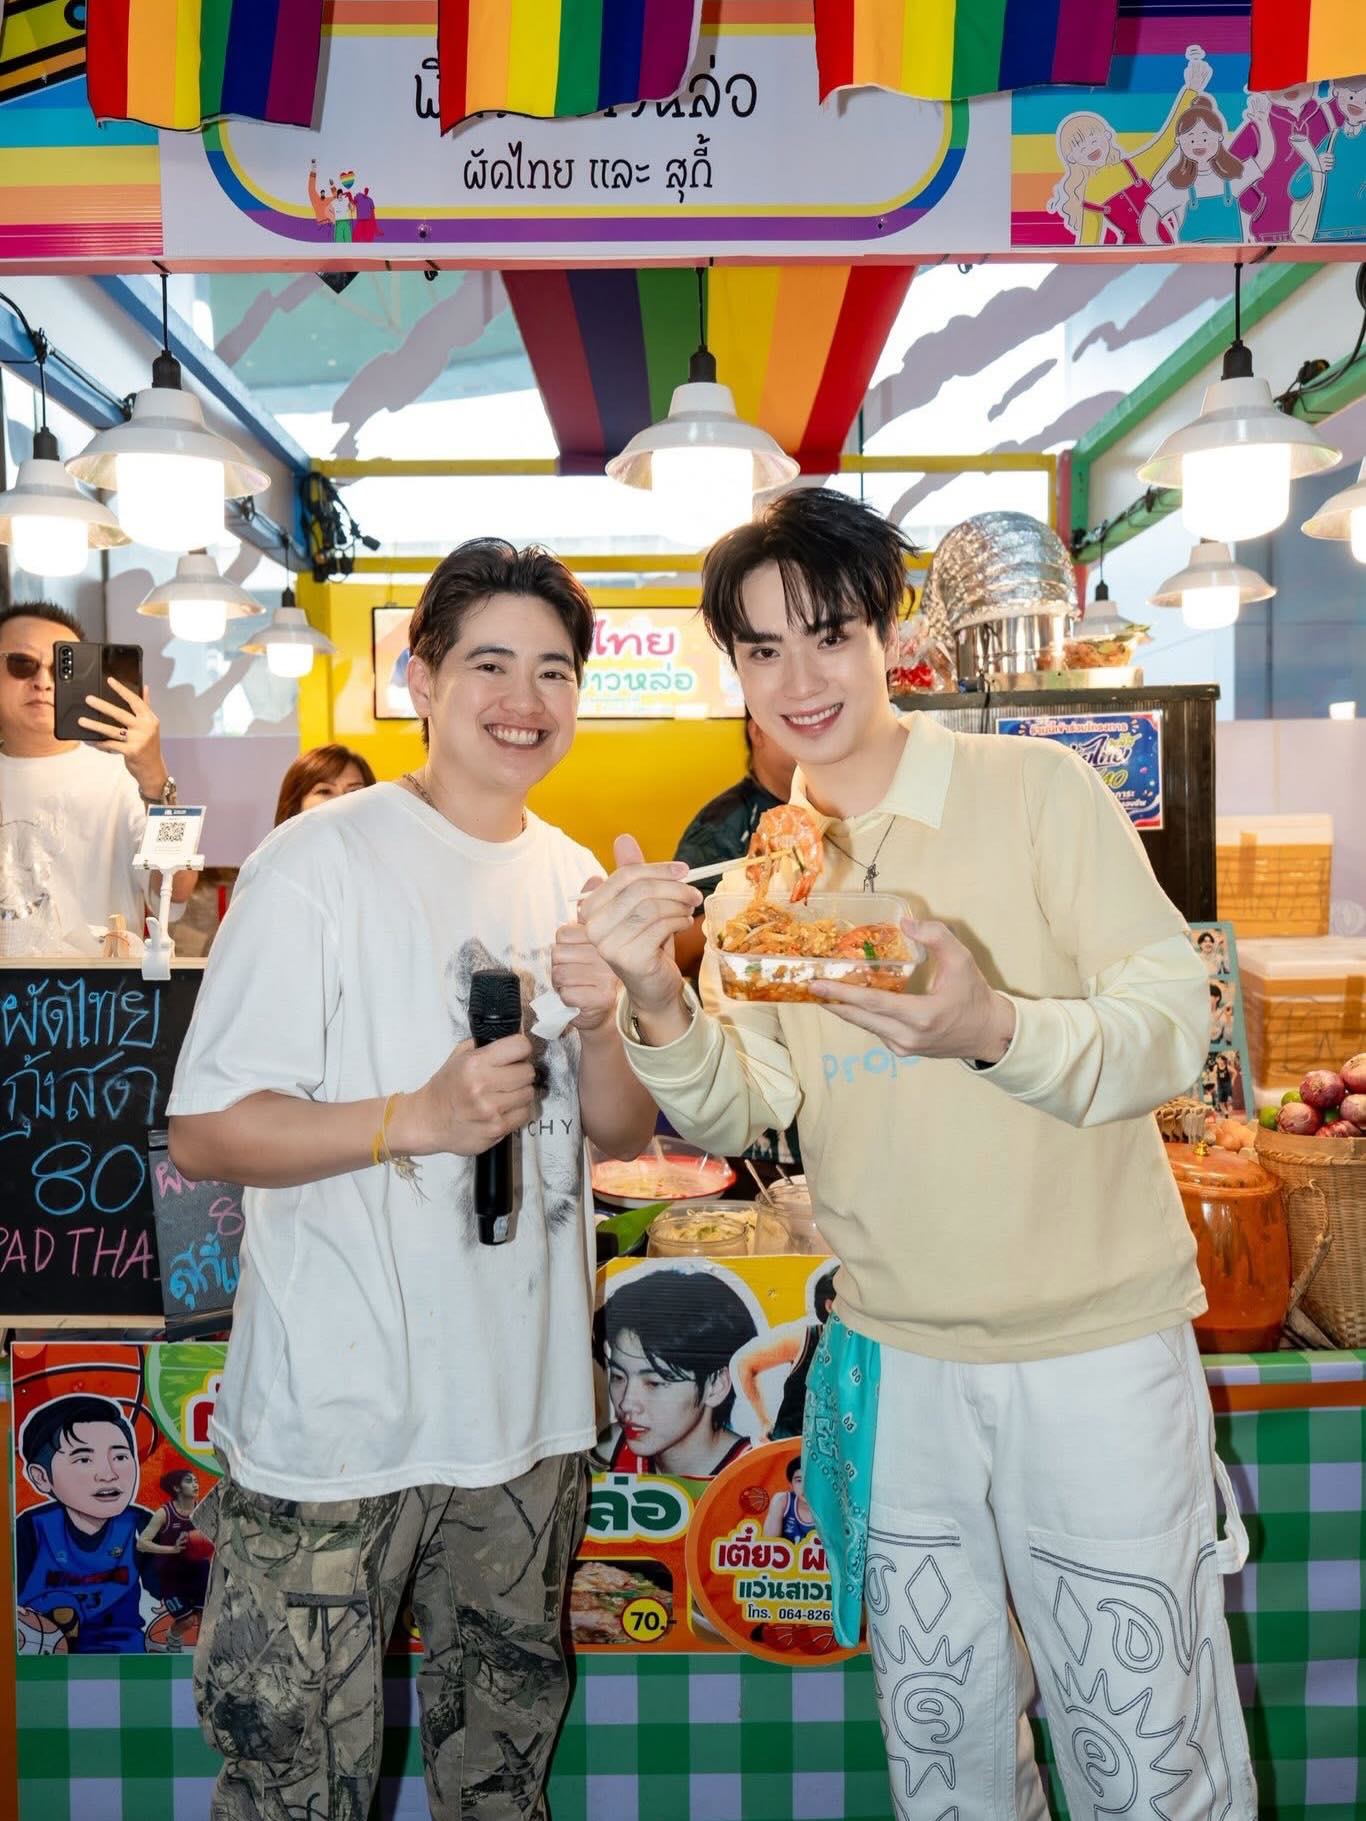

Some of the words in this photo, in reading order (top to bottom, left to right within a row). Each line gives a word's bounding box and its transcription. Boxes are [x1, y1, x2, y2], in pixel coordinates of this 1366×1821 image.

[463, 140, 574, 189] ผัดไทย
[590, 158, 651, 189] และ
[665, 133, 714, 204] สุกี้
[2, 976, 161, 1050] ผัดไทย
[0, 1051, 159, 1140] กุ้งสด
[31, 1141, 146, 1216] 80
[802, 1537, 832, 1571] ผั
